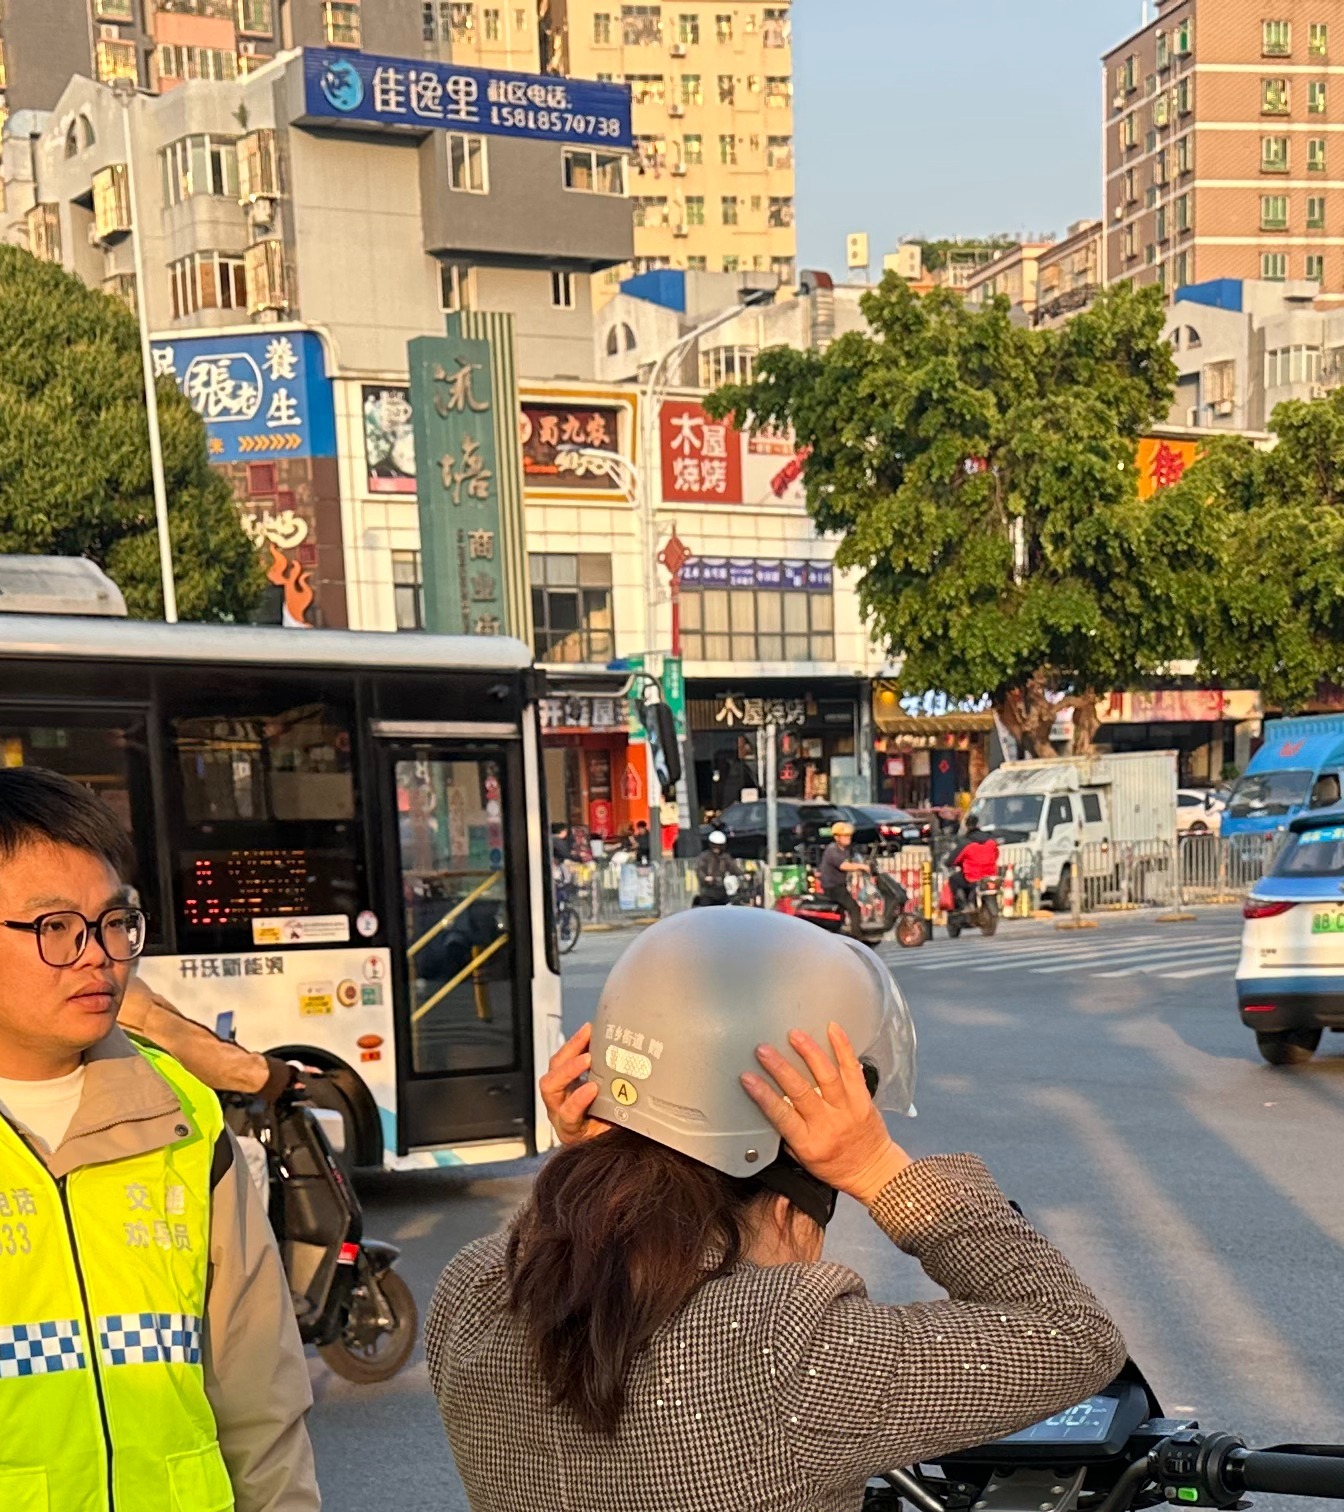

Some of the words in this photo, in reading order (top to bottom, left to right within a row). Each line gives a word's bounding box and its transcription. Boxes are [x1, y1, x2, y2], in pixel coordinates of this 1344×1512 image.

[490, 106, 621, 138] 15818570738
[669, 411, 728, 458] 木屋
[672, 457, 728, 494] 烧烤
[179, 956, 285, 979] 开沃新能源
[617, 1083, 629, 1102] A
